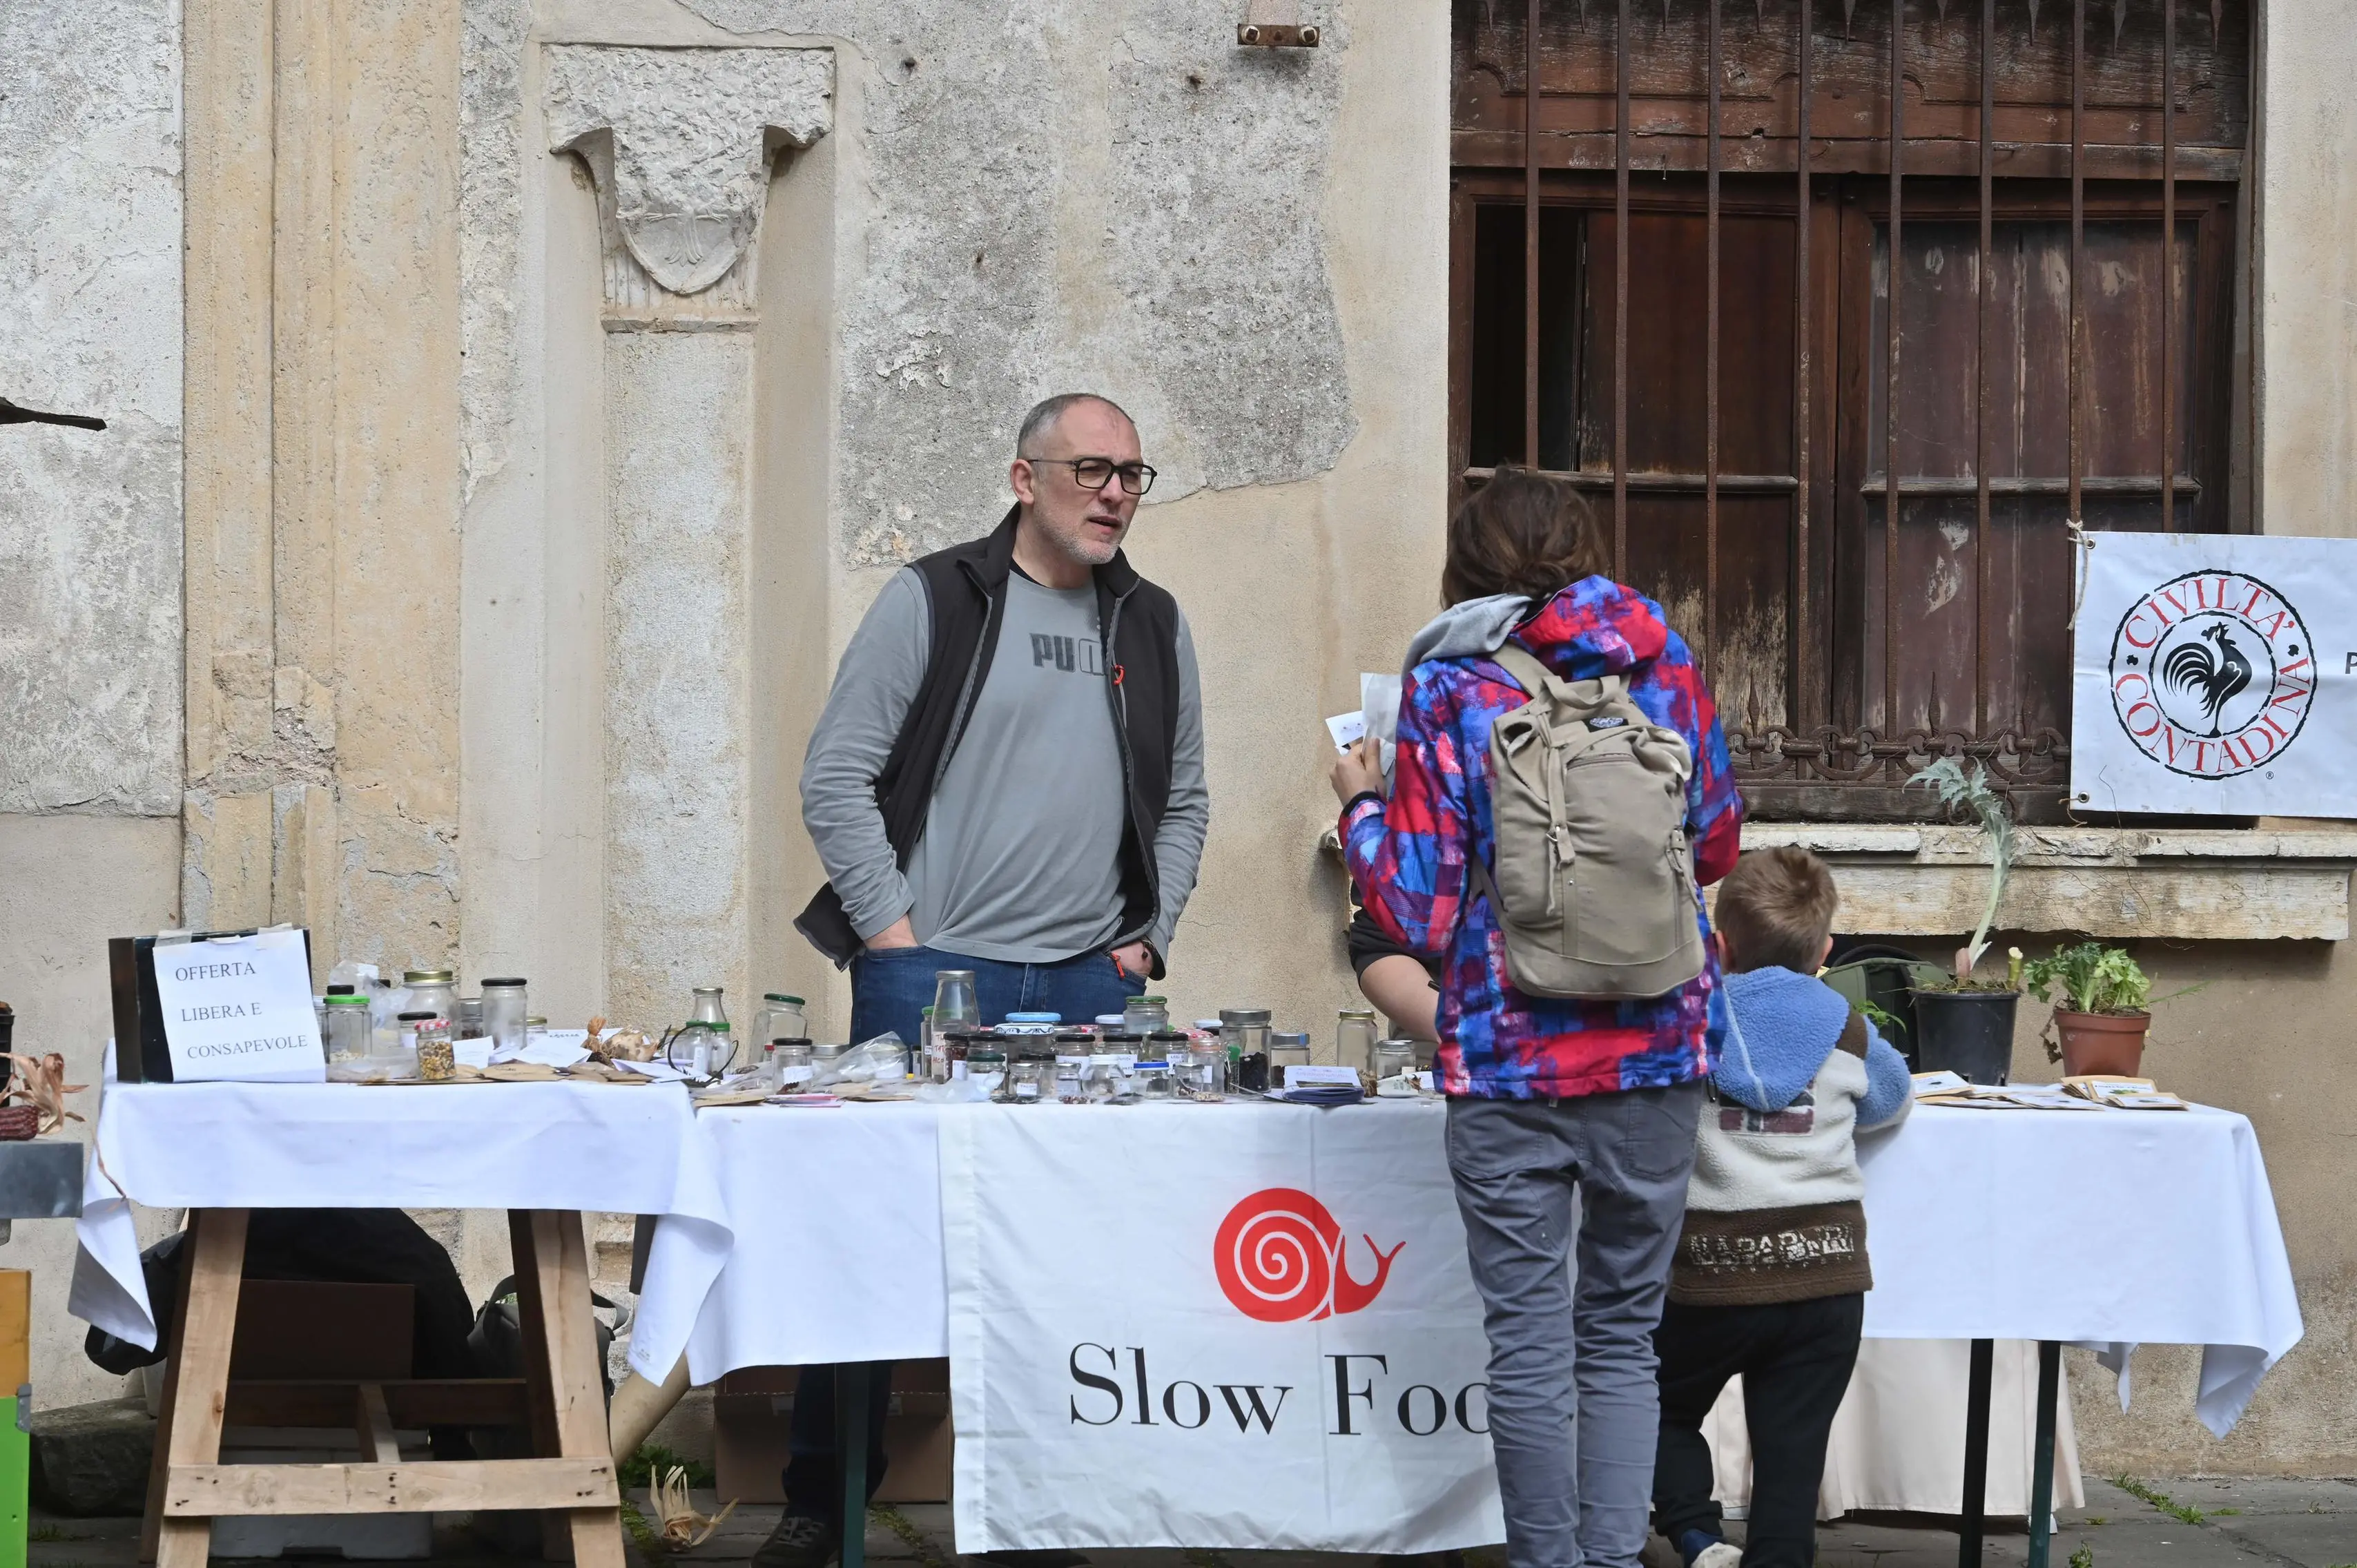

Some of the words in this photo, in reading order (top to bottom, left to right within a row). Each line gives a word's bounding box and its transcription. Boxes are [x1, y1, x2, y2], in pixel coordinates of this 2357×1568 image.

[2115, 655, 2312, 773] CONTADINA
[175, 961, 257, 981] OFFERTA
[181, 1005, 246, 1022] LIBERA
[251, 1003, 262, 1016] E
[187, 1035, 309, 1059] CONSAPEVOLE
[1069, 1342, 1294, 1435] Slow
[1323, 1354, 1491, 1437] Foo
